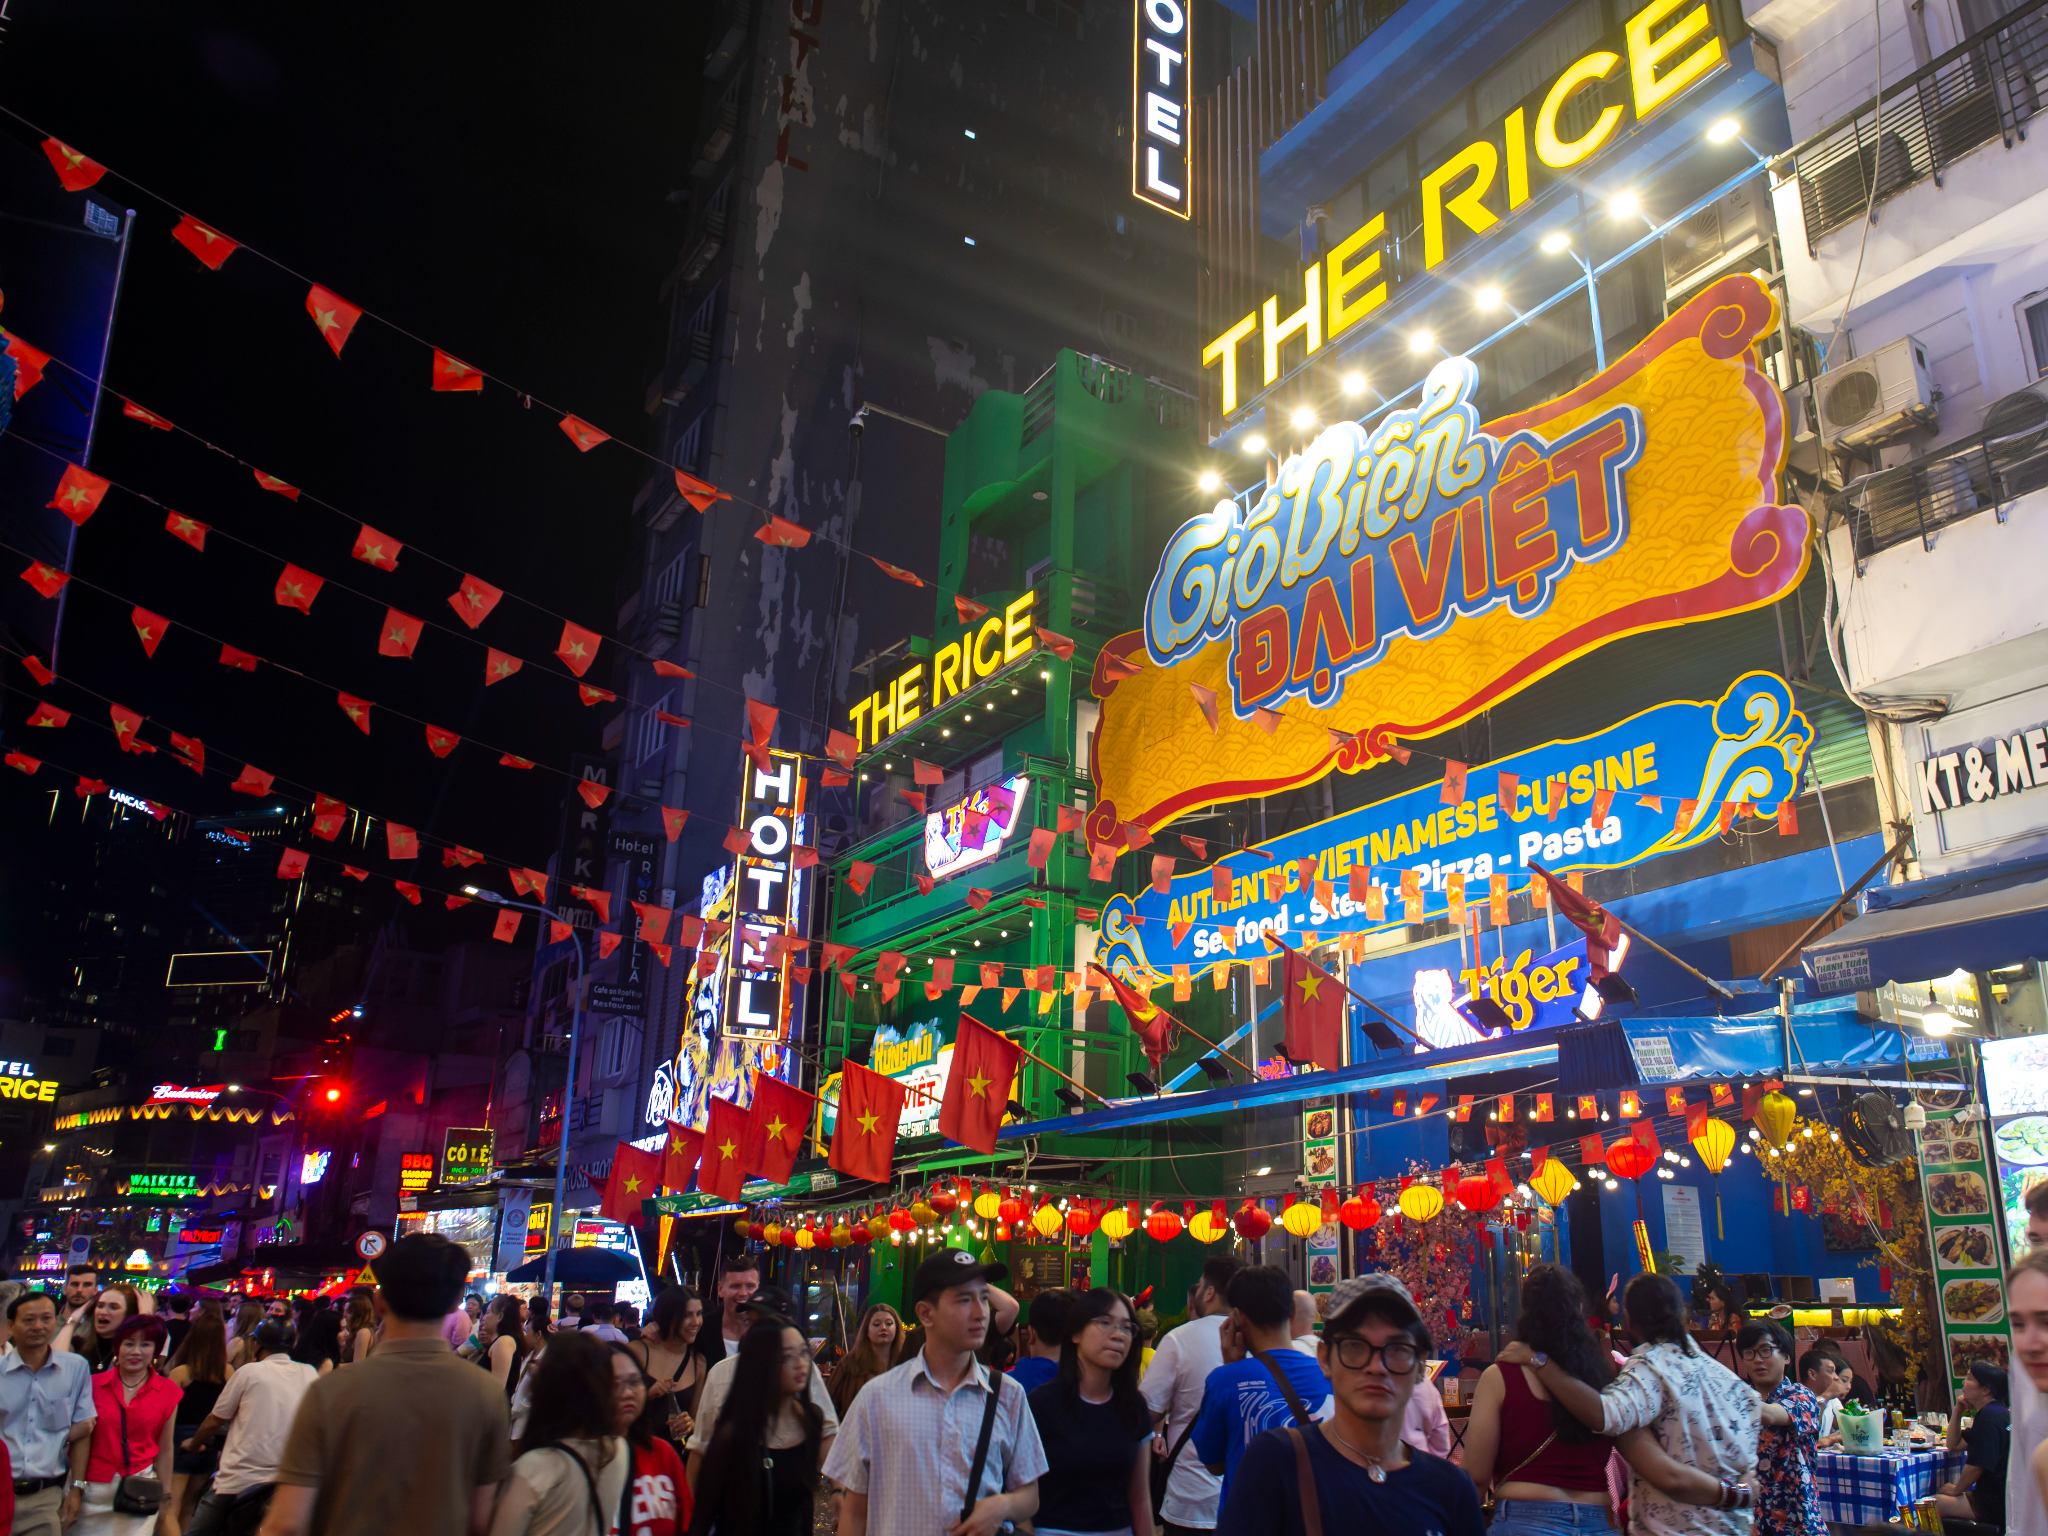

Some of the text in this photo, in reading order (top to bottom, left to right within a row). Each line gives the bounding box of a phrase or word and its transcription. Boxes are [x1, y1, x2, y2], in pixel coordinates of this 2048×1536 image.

[1145, 0, 1184, 203] OTEL
[1202, 0, 1728, 416] THE RICE
[1234, 420, 1625, 706] ĐẠI VIỆT
[850, 590, 1034, 753] THE RICE
[109, 788, 155, 815] LANCAS
[1915, 726, 2048, 815] KT&ME
[614, 836, 654, 855] Hotel
[1167, 742, 1659, 930] AUTENTC VIETNAMESE CUISINE
[1194, 904, 1289, 958] Sefood
[1309, 875, 1389, 926] Stek
[1518, 815, 1622, 868] Pasta
[1459, 948, 1579, 1030] Tiger
[0, 1076, 59, 1102] RICE
[152, 1085, 221, 1100] Budweiser
[130, 1174, 196, 1188] WAIKIKI
[401, 1154, 434, 1169] BBQ
[446, 1144, 468, 1162] CÔ
